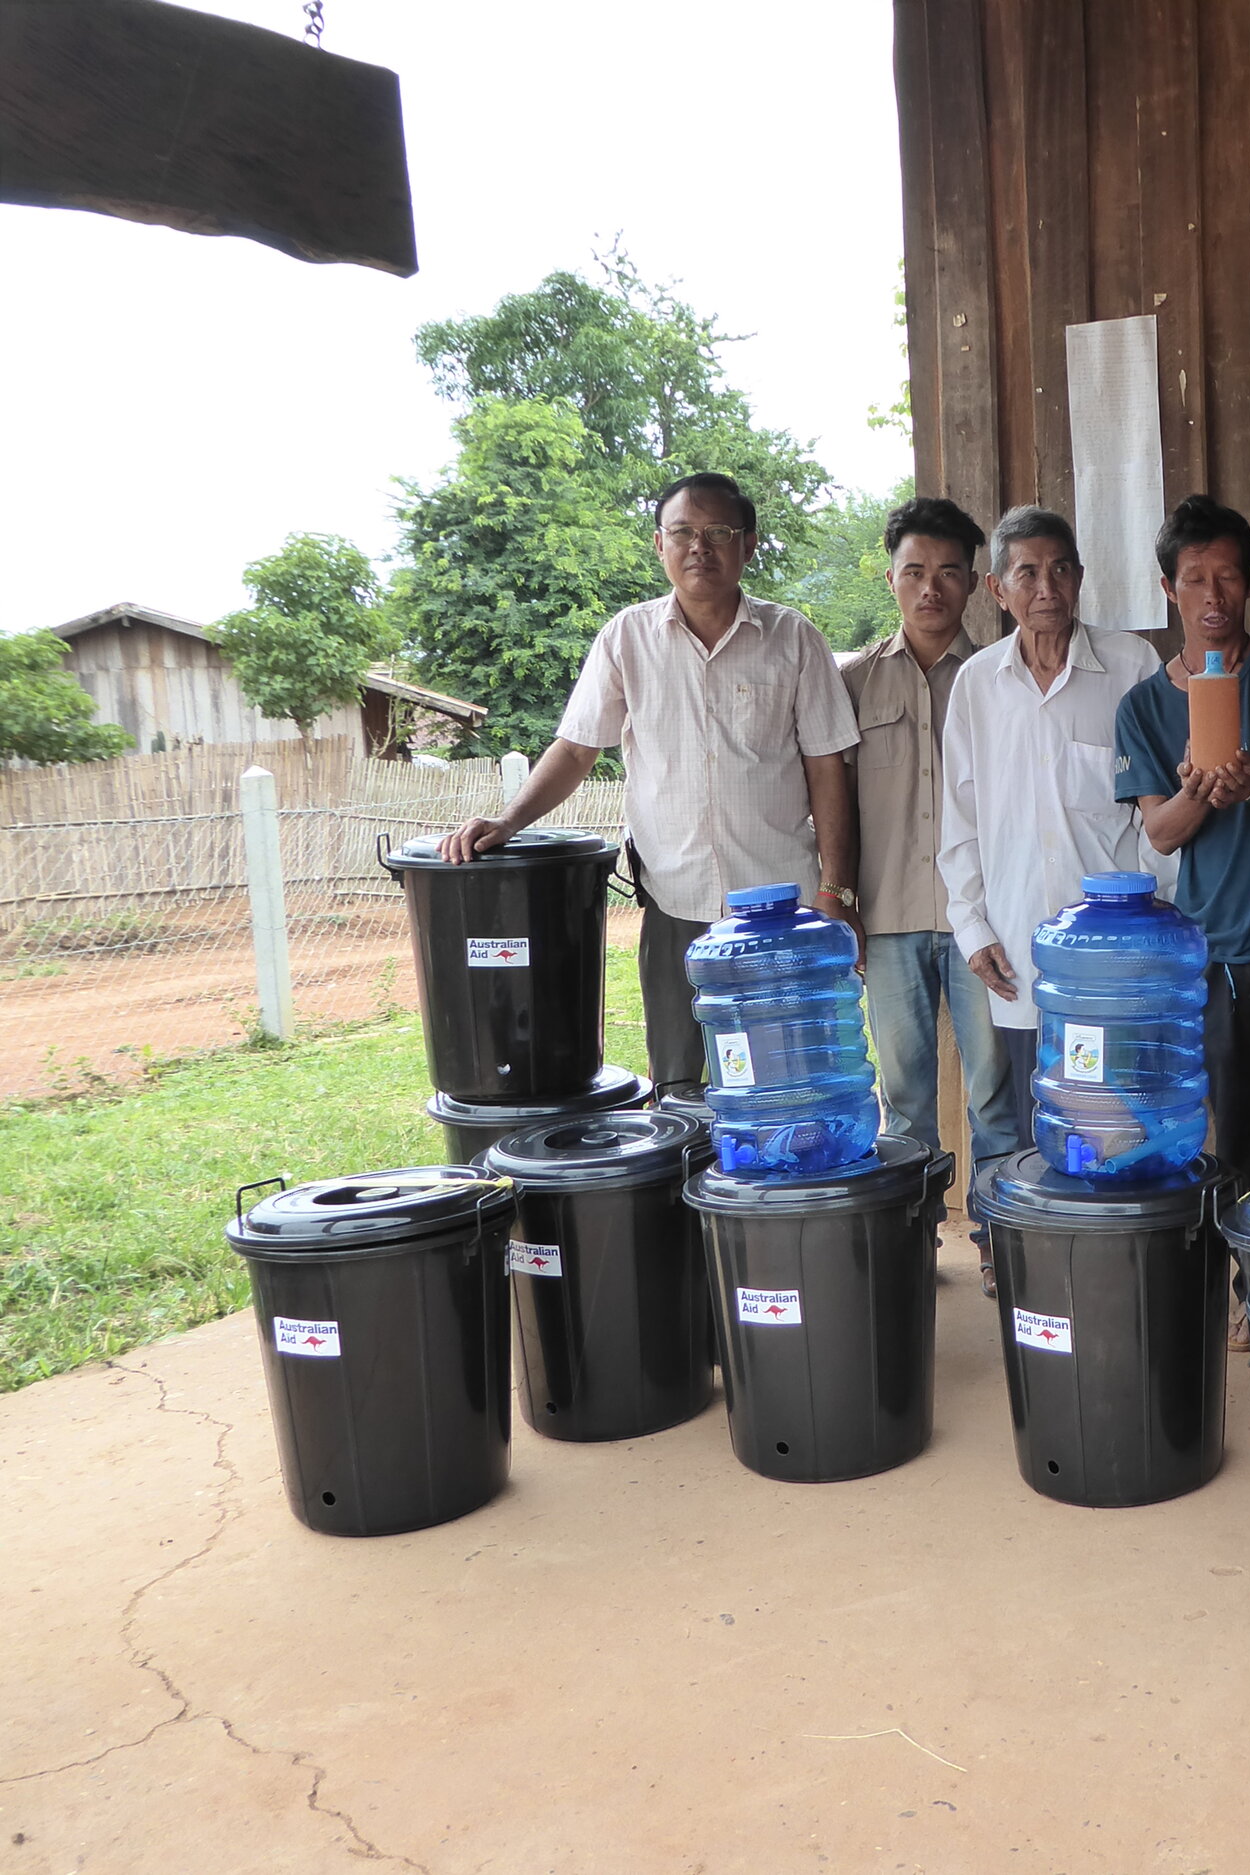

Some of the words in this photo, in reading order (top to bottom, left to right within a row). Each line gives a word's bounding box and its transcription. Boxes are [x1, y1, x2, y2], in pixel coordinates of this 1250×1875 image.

[470, 940, 527, 948] Australian
[470, 950, 488, 958] Aid
[509, 1241, 558, 1256] Australian
[511, 1252, 524, 1263] Aid
[741, 1291, 797, 1303] Australian
[743, 1303, 758, 1313] Aid
[1017, 1310, 1068, 1330] Australian
[280, 1320, 337, 1334] Australian
[1018, 1322, 1032, 1336] Aid
[281, 1333, 296, 1344] Aid
